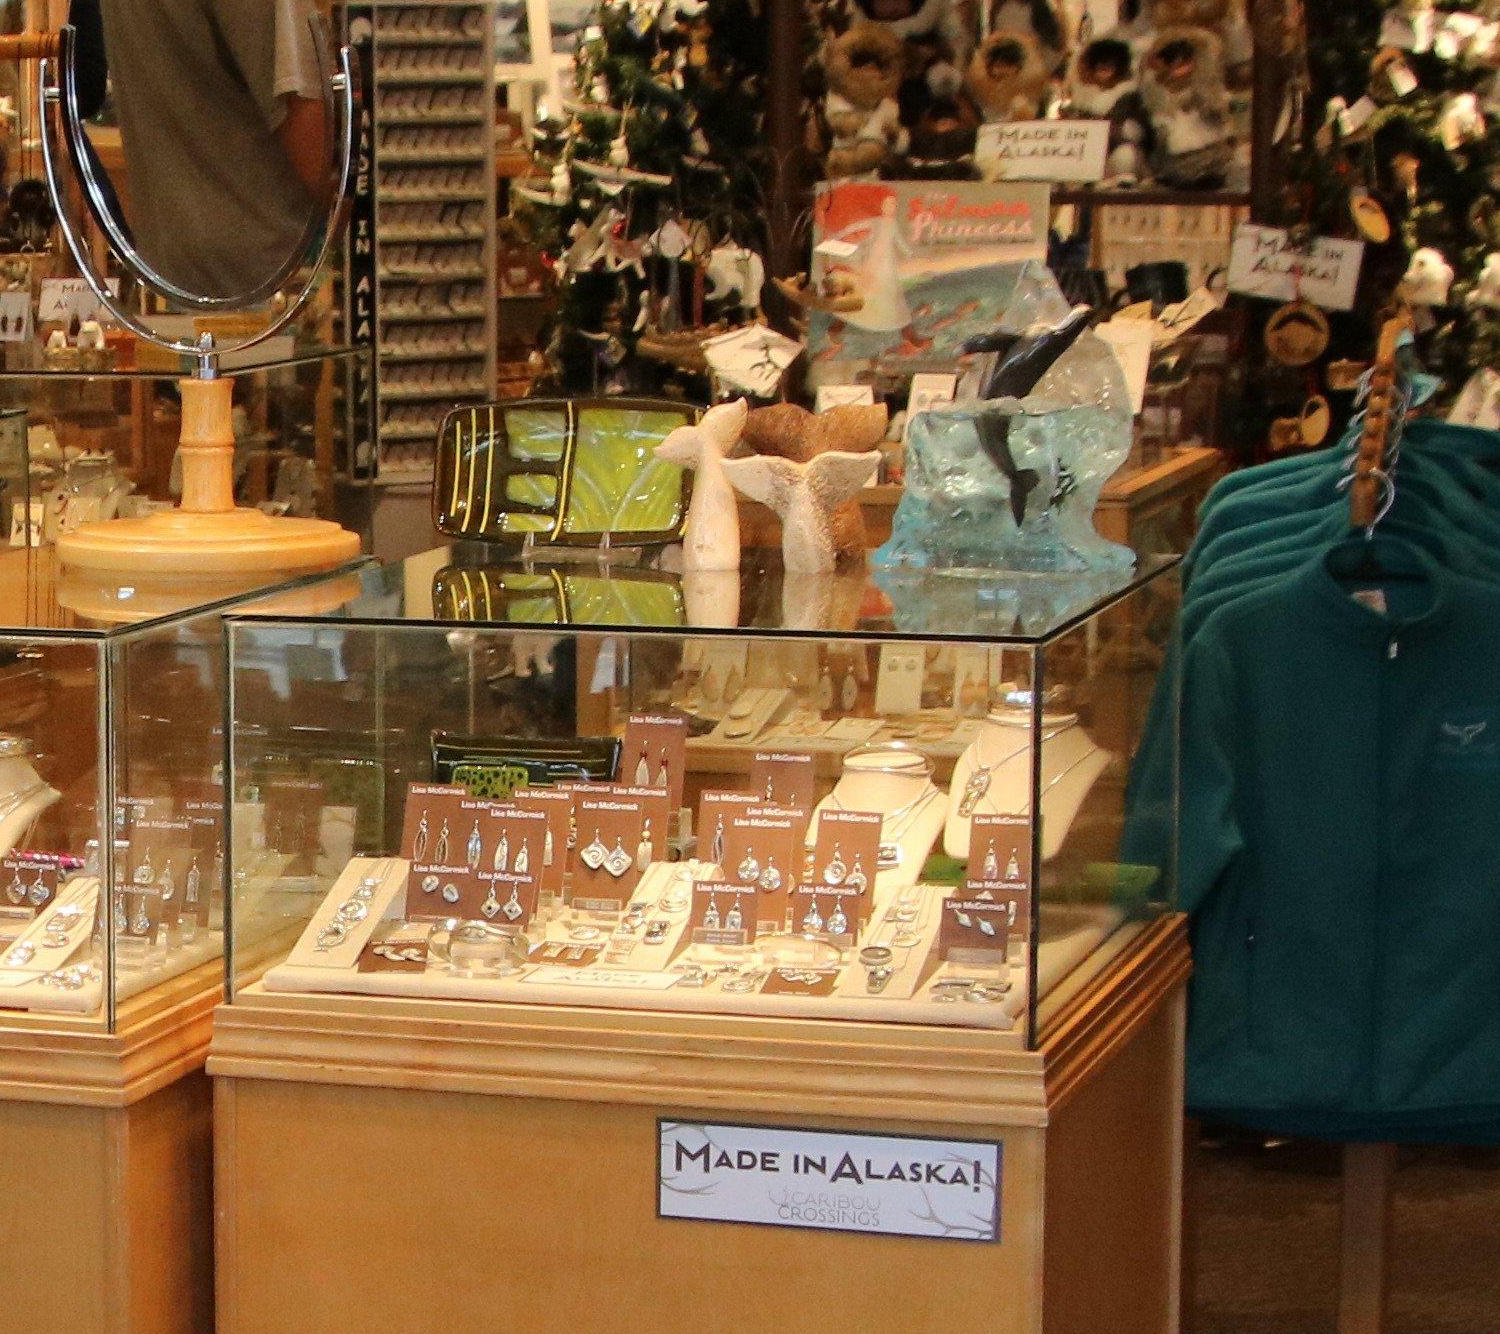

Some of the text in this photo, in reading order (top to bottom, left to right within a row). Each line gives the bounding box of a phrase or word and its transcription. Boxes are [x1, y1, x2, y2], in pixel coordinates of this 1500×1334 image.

[1000, 128, 1058, 142] MADE
[999, 142, 1085, 161] ALASKA!
[357, 220, 370, 254] IN
[630, 716, 683, 725] Lisa McCormick
[756, 753, 811, 762] Lisa McCormick
[412, 786, 466, 796] Lisa McCormick
[557, 783, 611, 792] Lisa McCormick
[613, 787, 667, 797] Lisa McCormick
[515, 790, 570, 800] Lisa McCormick
[704, 793, 760, 803] Lisa McCormick
[582, 801, 638, 811] Lisa McCormick
[490, 809, 546, 819] Lisa McCormick
[747, 807, 804, 818] Lisa McCormick
[734, 818, 791, 829] Lisa McCormick
[822, 813, 880, 824] Lisa McCormick
[151, 820, 189, 830] McCormick
[413, 864, 469, 874] Lisa McCormick
[477, 871, 533, 882] Lisa McCormick
[697, 883, 756, 894] Lisa McCormick
[799, 885, 857, 896] Lisa McCormick
[967, 880, 1027, 890] Lisa McCormick
[946, 901, 1006, 912] Lisa McCormick
[674, 1139, 982, 1194] MADE IN ALASKA!
[790, 1190, 882, 1212] CARIBOU
[776, 1203, 881, 1227] CROSSINGS
